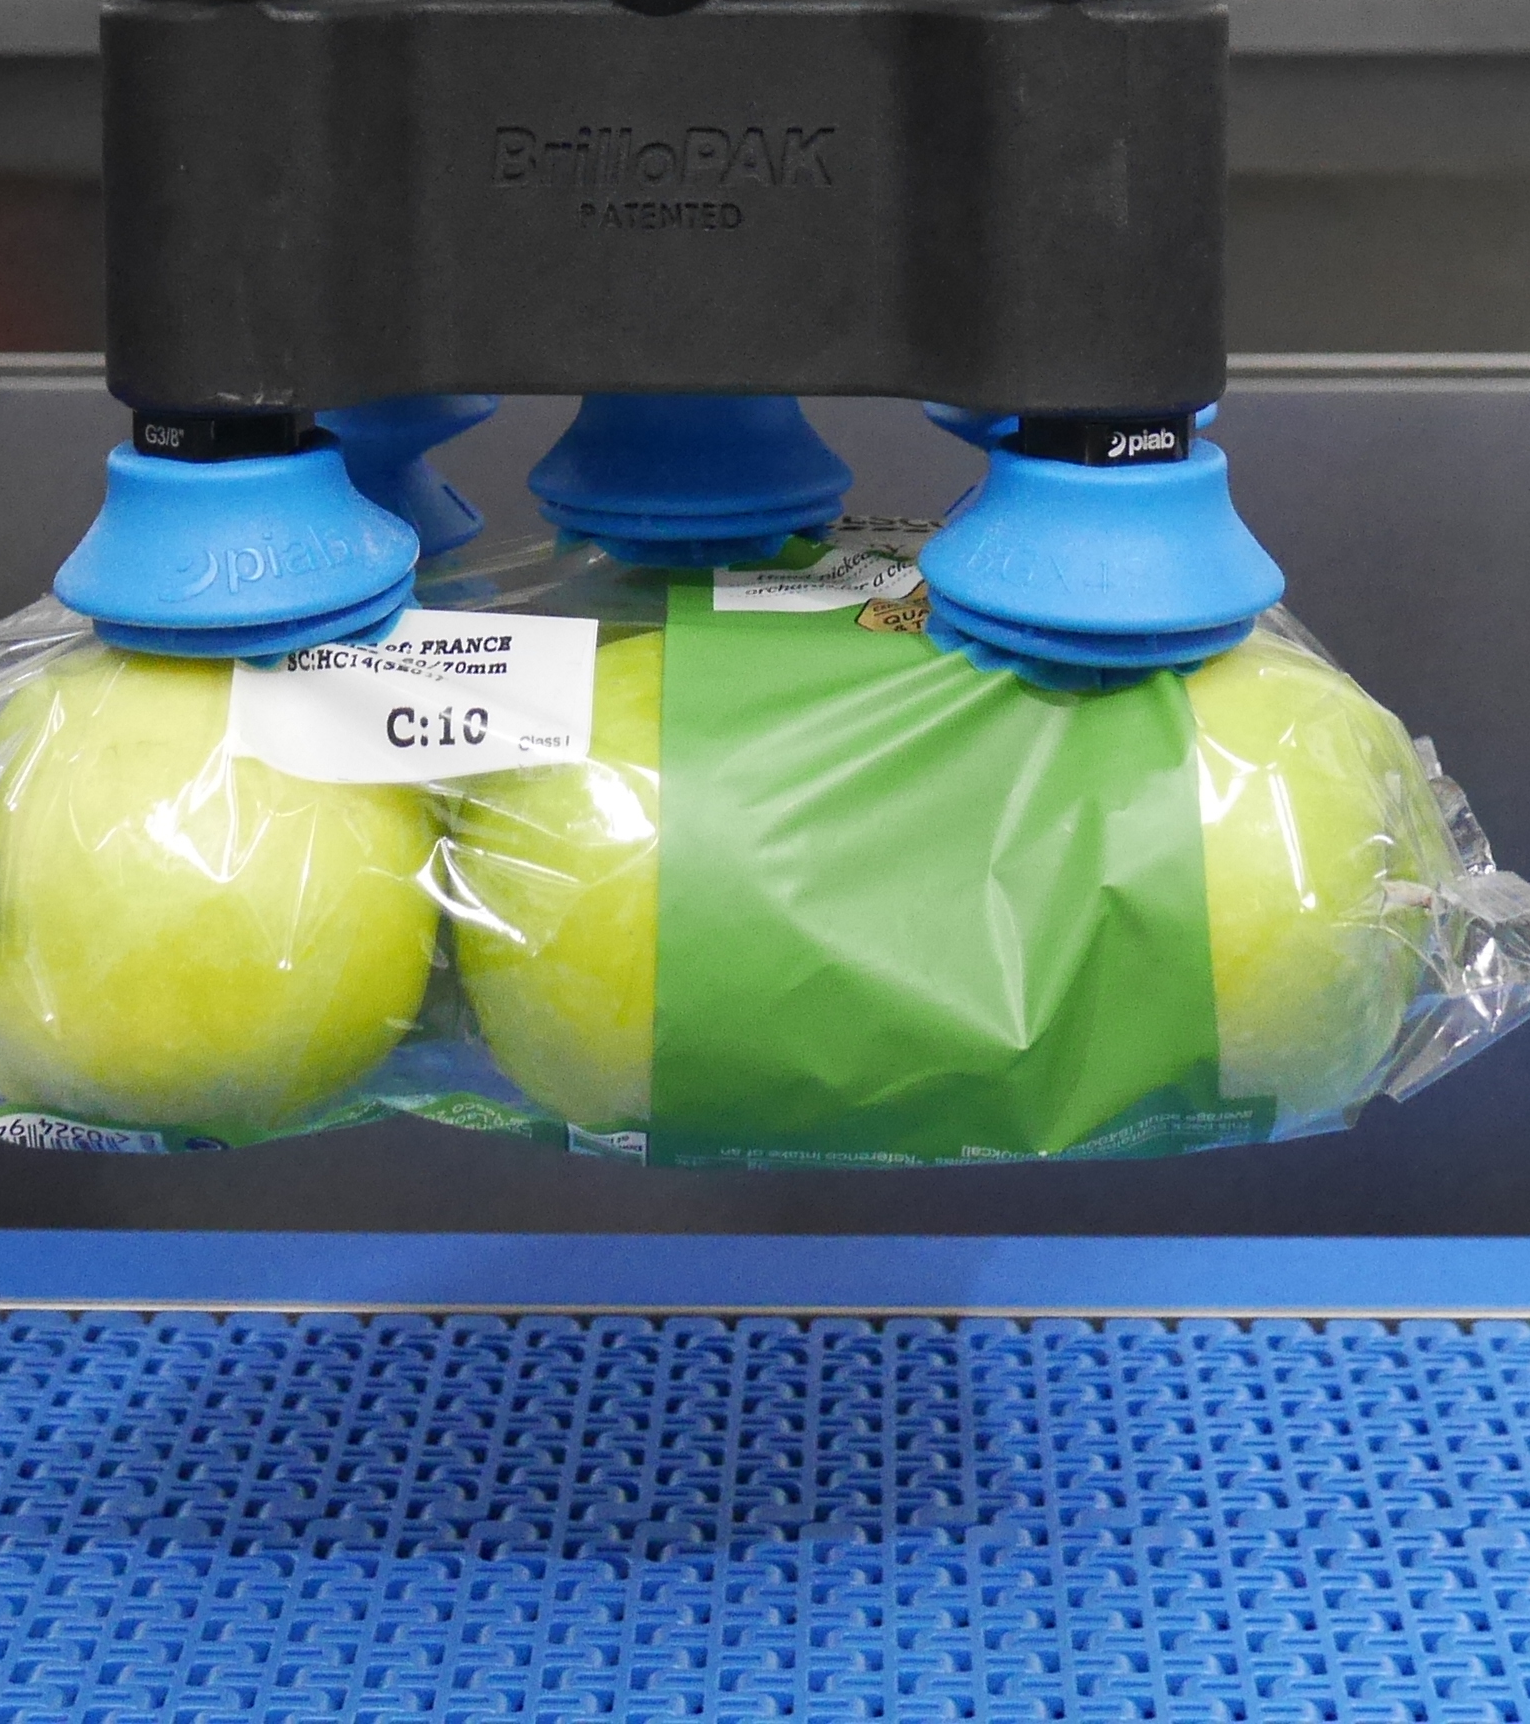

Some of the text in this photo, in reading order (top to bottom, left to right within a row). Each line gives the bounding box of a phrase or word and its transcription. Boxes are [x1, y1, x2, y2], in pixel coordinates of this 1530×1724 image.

[492, 125, 837, 187] BrilloPAK
[578, 201, 744, 231] PATENTED
[1128, 428, 1176, 457] piab
[419, 636, 512, 656] FRANCE
[385, 706, 489, 748] C:10
